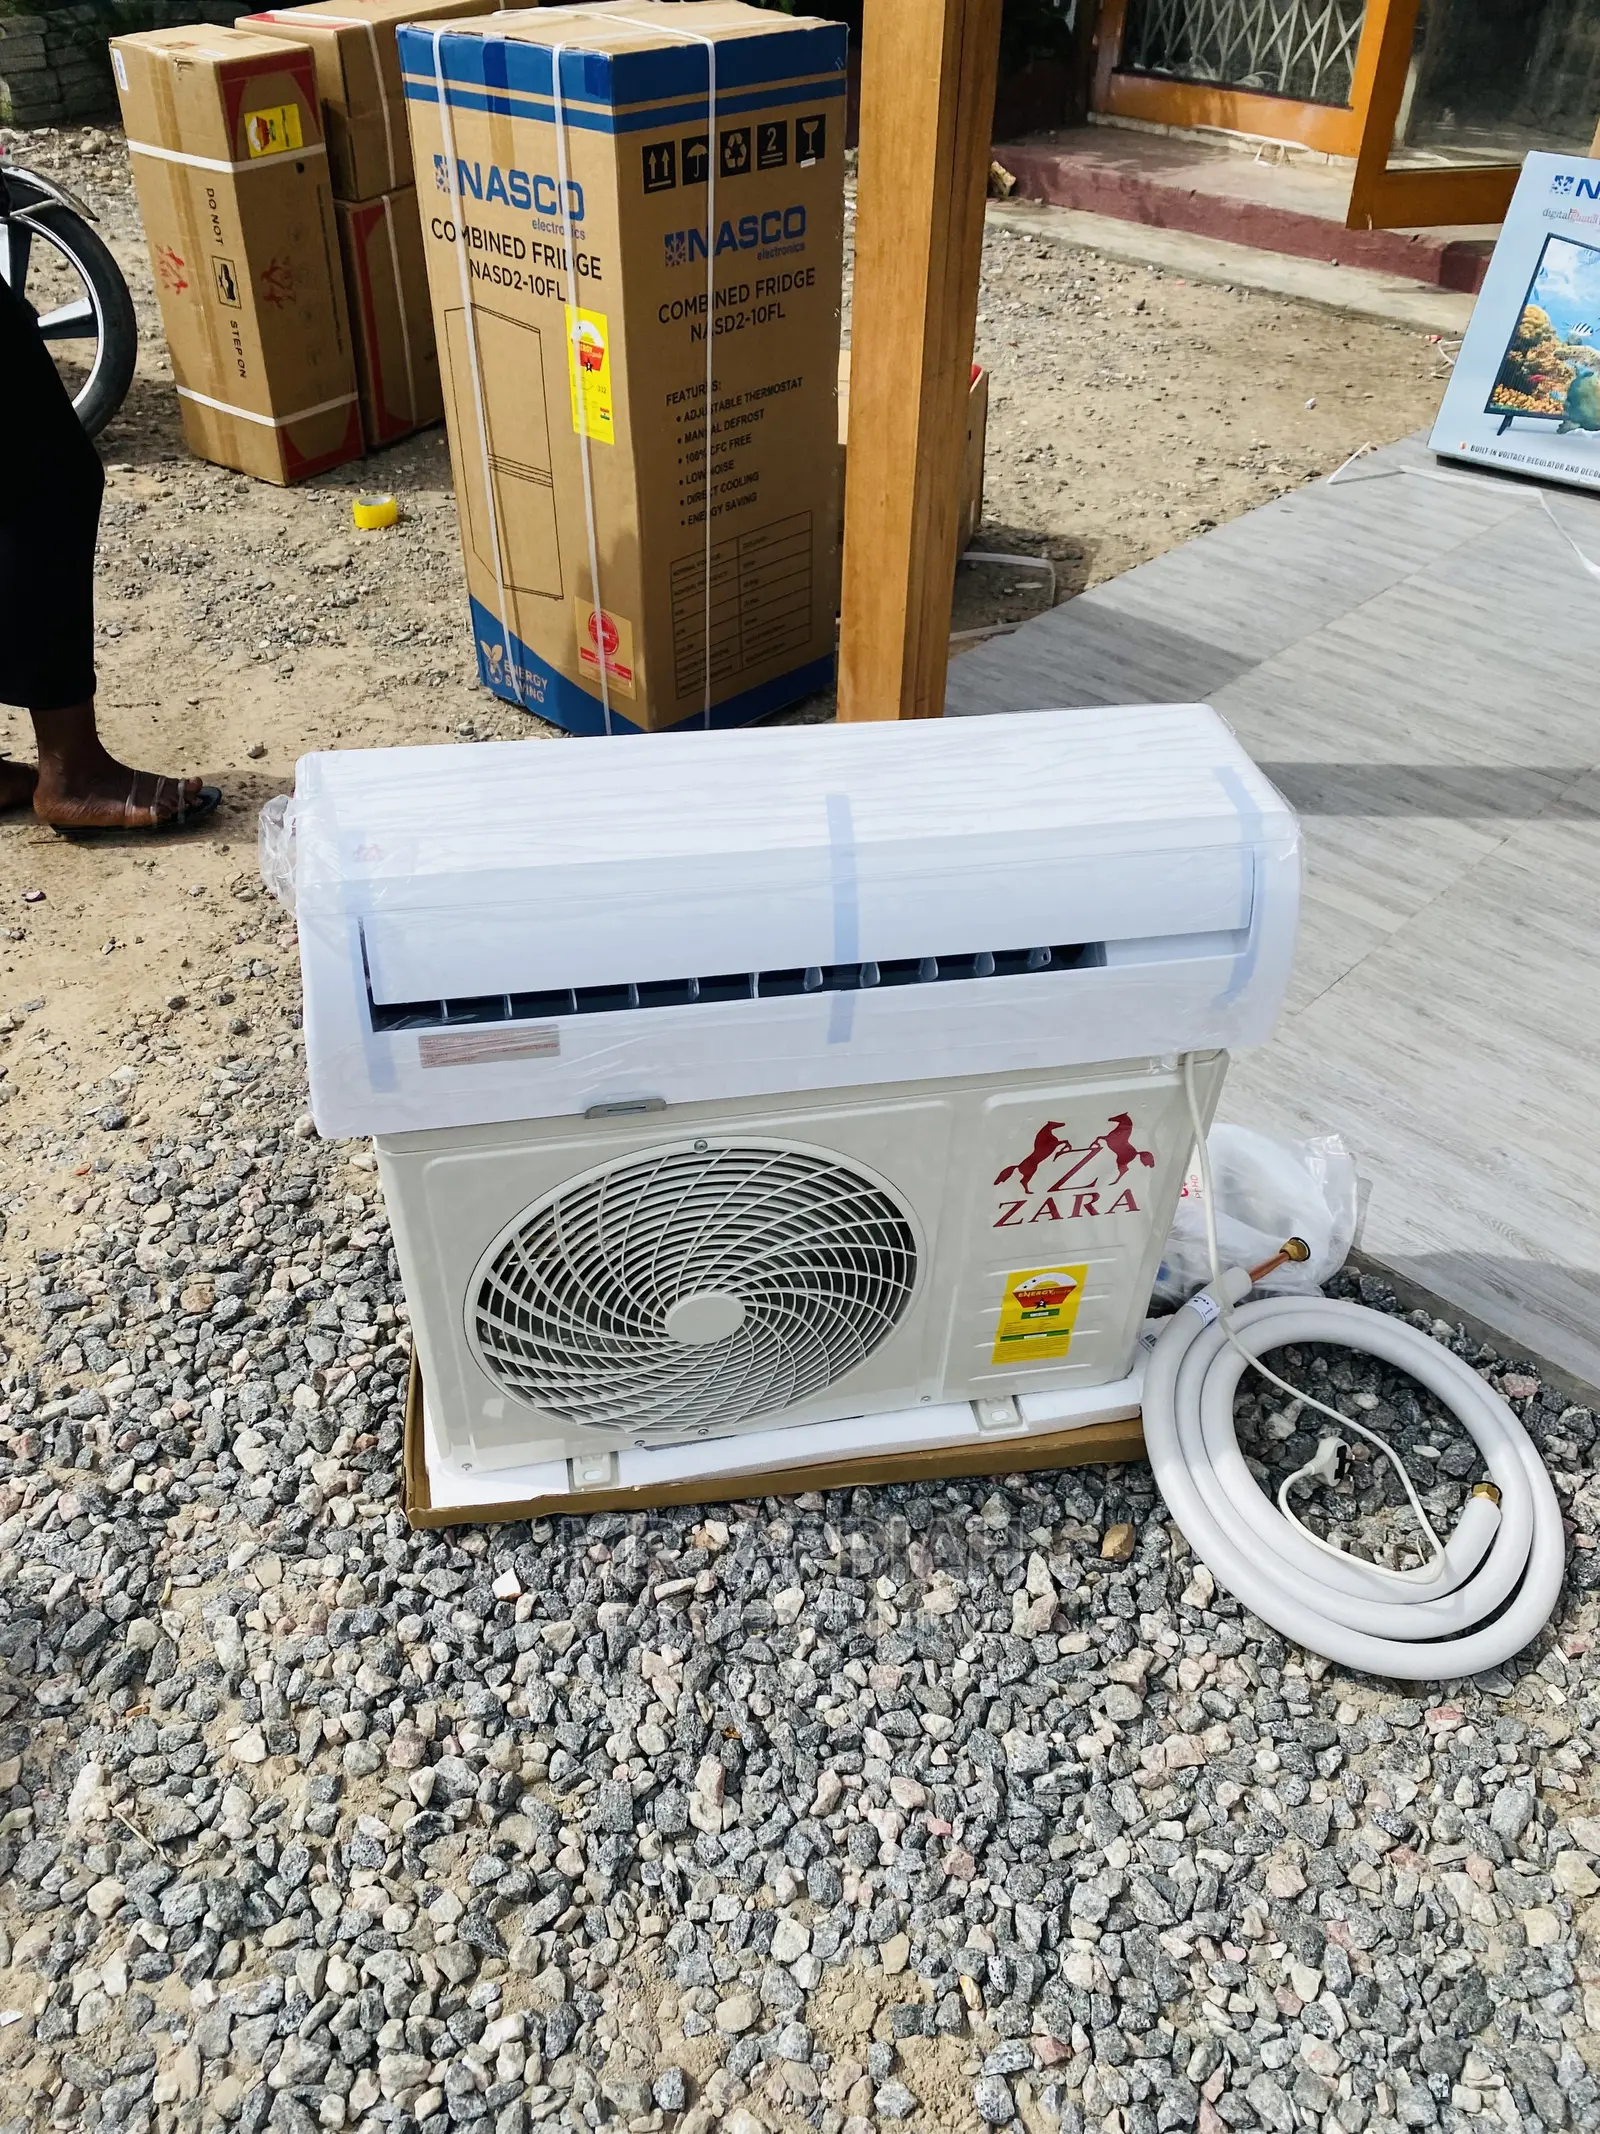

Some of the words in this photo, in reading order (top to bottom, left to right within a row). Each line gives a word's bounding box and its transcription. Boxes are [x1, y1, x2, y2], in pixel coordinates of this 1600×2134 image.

[767, 127, 777, 152] 2
[205, 187, 218, 210] DO
[457, 158, 585, 222] NASCO
[210, 213, 224, 245] NOT
[431, 217, 526, 260] COMBINED
[532, 218, 586, 240] electroics
[688, 205, 806, 262] NASCO
[757, 242, 806, 261] electronics
[469, 258, 567, 302] NASD2-10FL
[658, 284, 750, 324] COMBINED
[756, 267, 816, 299] FRIDGE
[230, 320, 243, 357] STEP
[237, 358, 247, 379] ON
[666, 379, 722, 407] FEATURS:
[744, 376, 803, 404] THERMOSTAT
[684, 423, 722, 444] MANAL
[724, 409, 765, 431] DEFROST
[729, 433, 752, 451] FREE
[720, 471, 760, 494] COOLING
[1565, 464, 1579, 474] AND
[688, 503, 724, 526] ENEGY
[725, 492, 758, 512] SAVING
[505, 673, 545, 704] SVING
[993, 1188, 1141, 1228] ZARA
[1018, 1288, 1056, 1299] ENERGY
